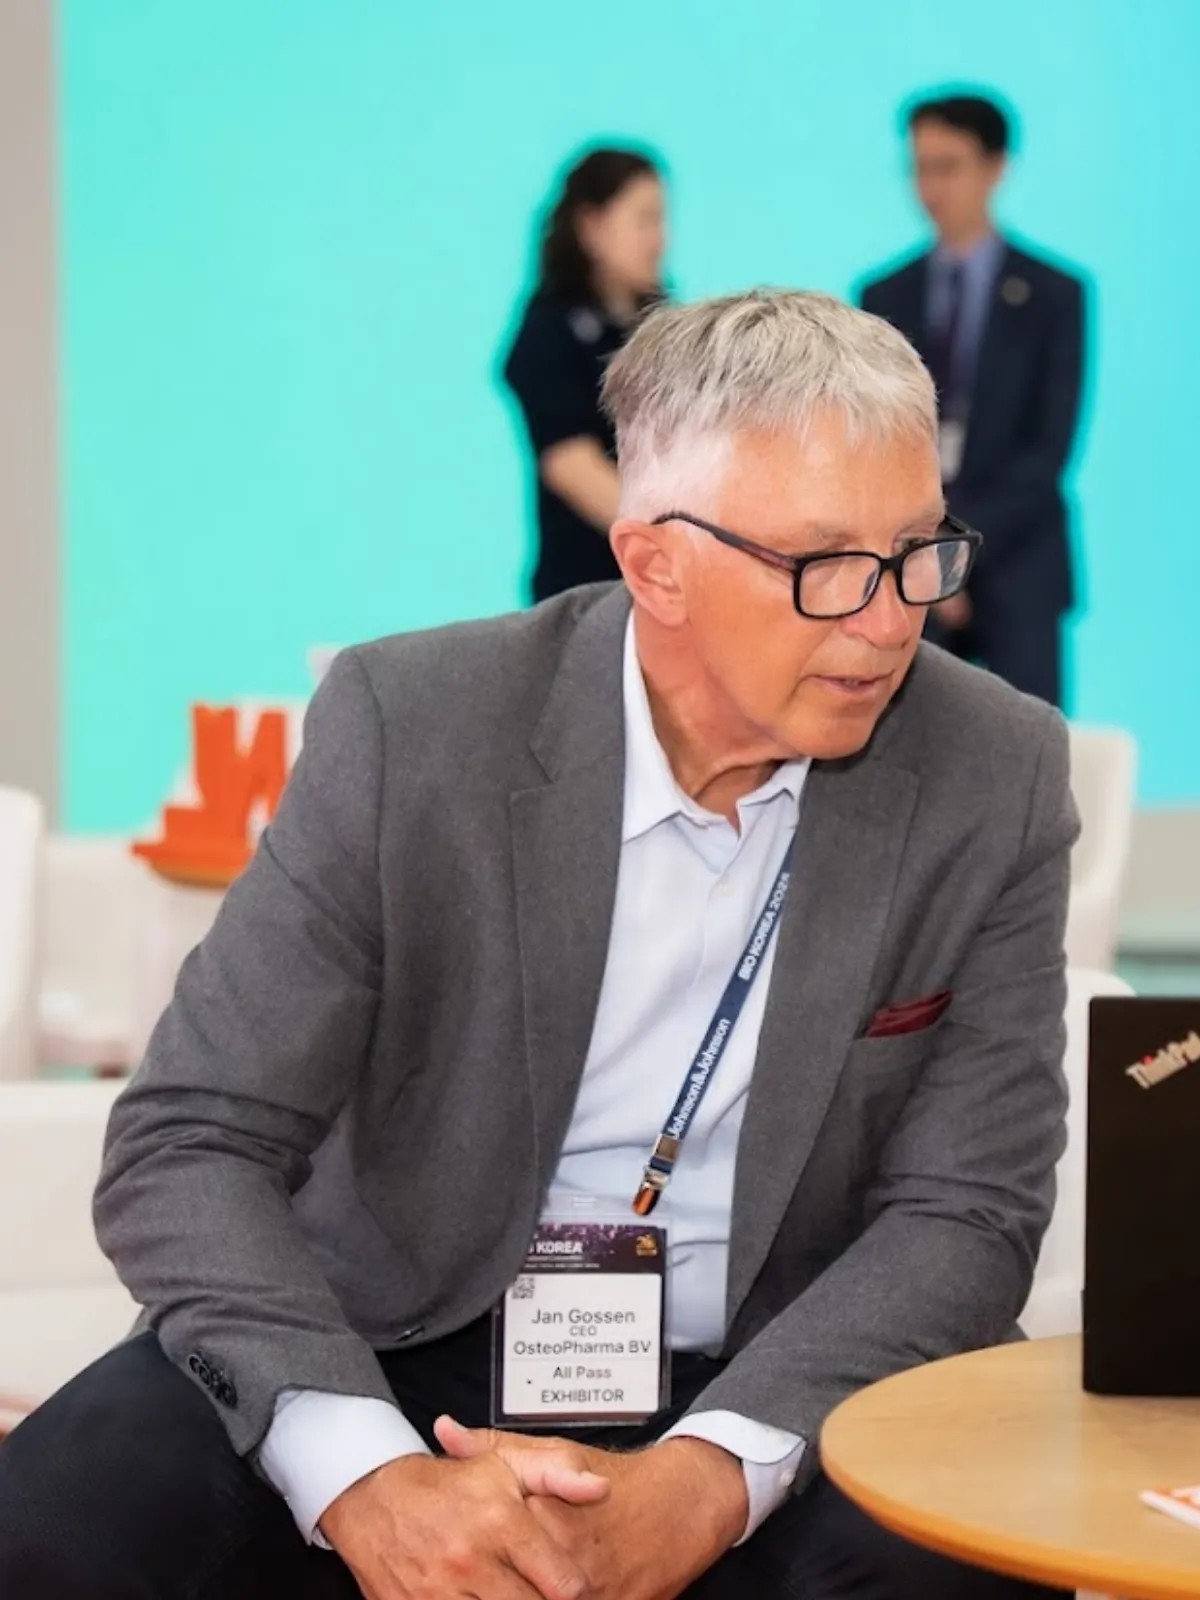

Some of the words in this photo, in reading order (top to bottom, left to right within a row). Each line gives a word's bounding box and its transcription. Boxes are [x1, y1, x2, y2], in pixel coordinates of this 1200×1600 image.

[748, 910, 777, 957] KOREA
[536, 1240, 583, 1254] KOREA
[531, 1309, 563, 1324] Jan
[568, 1308, 636, 1324] Gossen
[569, 1325, 597, 1337] CEO
[513, 1340, 625, 1355] OsteoPharma
[628, 1340, 651, 1354] BV
[553, 1366, 572, 1379] All
[576, 1366, 612, 1379] Pass
[541, 1389, 625, 1404] EXHIBITOR
